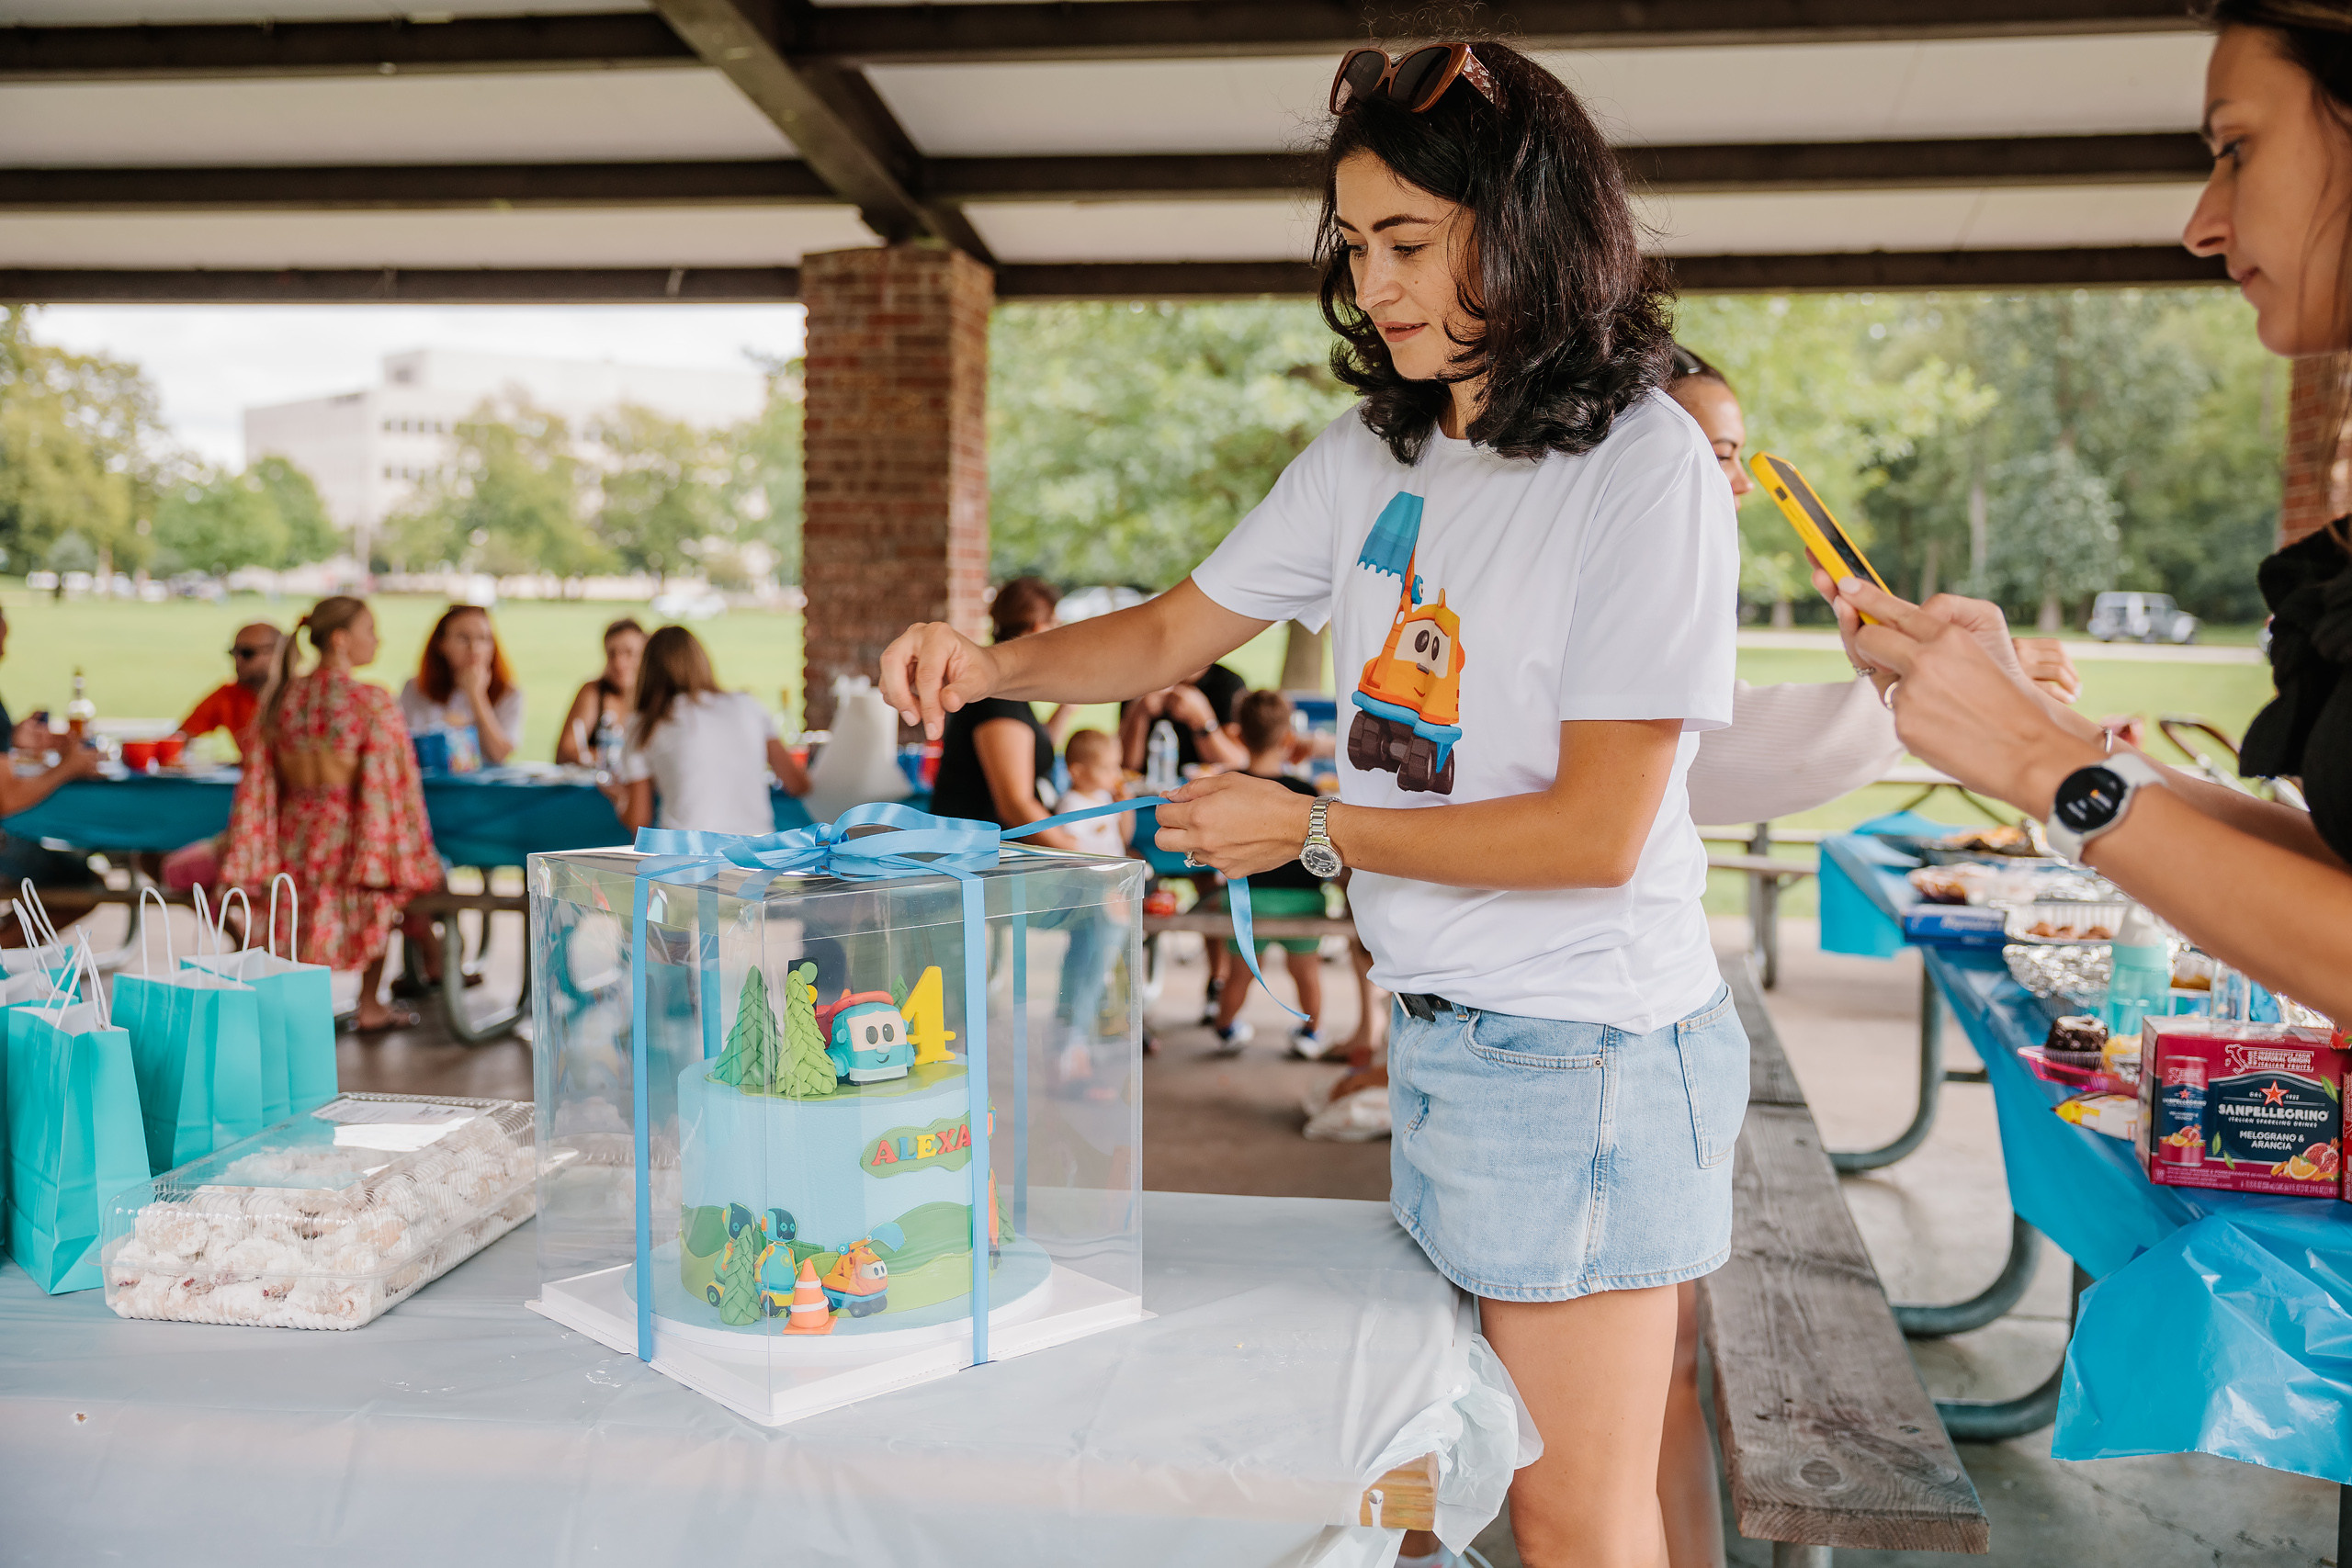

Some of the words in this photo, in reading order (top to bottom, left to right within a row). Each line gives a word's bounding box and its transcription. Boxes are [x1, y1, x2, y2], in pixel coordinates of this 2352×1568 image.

[900, 965, 956, 1066] 4
[2218, 1103, 2329, 1122] SANPELLEGRINO
[2228, 1116, 2254, 1124] ITALIAN
[2256, 1118, 2291, 1127] SPARKLING
[2293, 1120, 2318, 1129] DRINKS
[2239, 1130, 2297, 1143] MELOGRANO
[2298, 1134, 2305, 1143] &
[2251, 1140, 2292, 1151] ARANCIA
